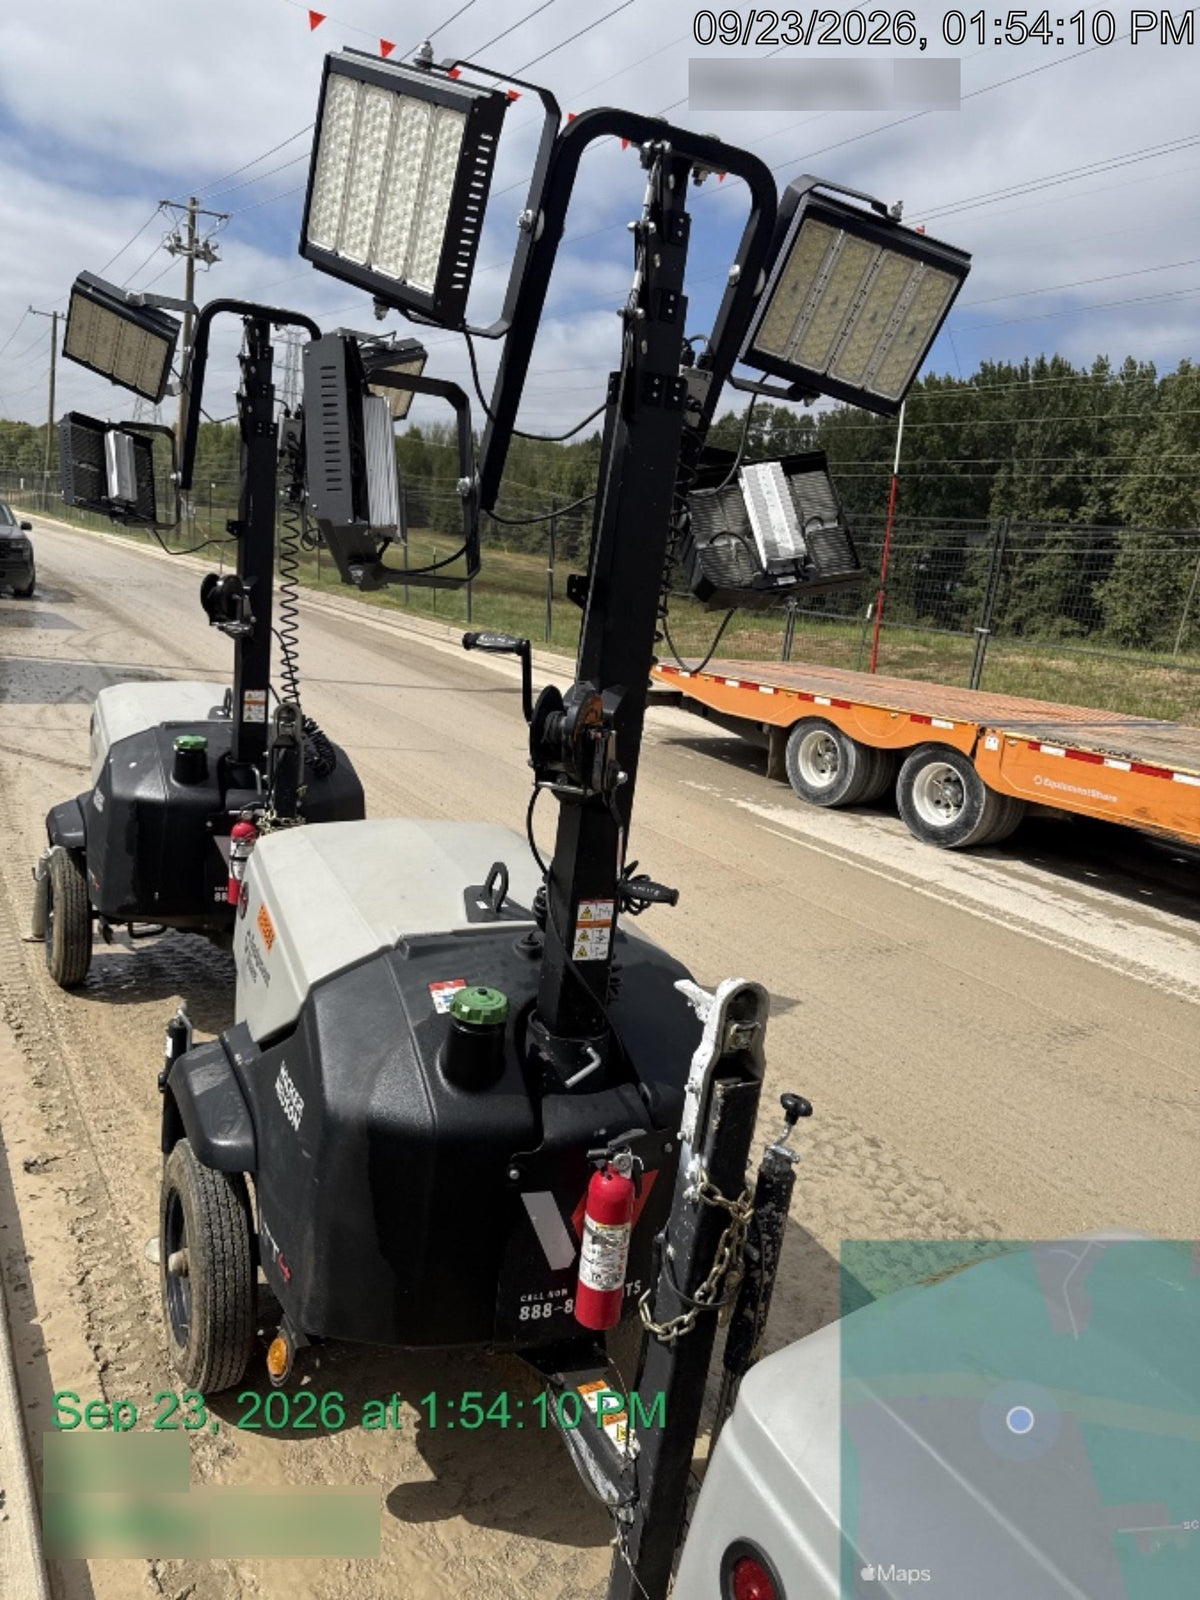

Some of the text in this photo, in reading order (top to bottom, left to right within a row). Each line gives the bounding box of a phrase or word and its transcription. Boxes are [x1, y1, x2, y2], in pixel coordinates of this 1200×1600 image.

[518, 1280, 642, 1321] 888-8 TS
[520, 1288, 569, 1303] CALL NOW
